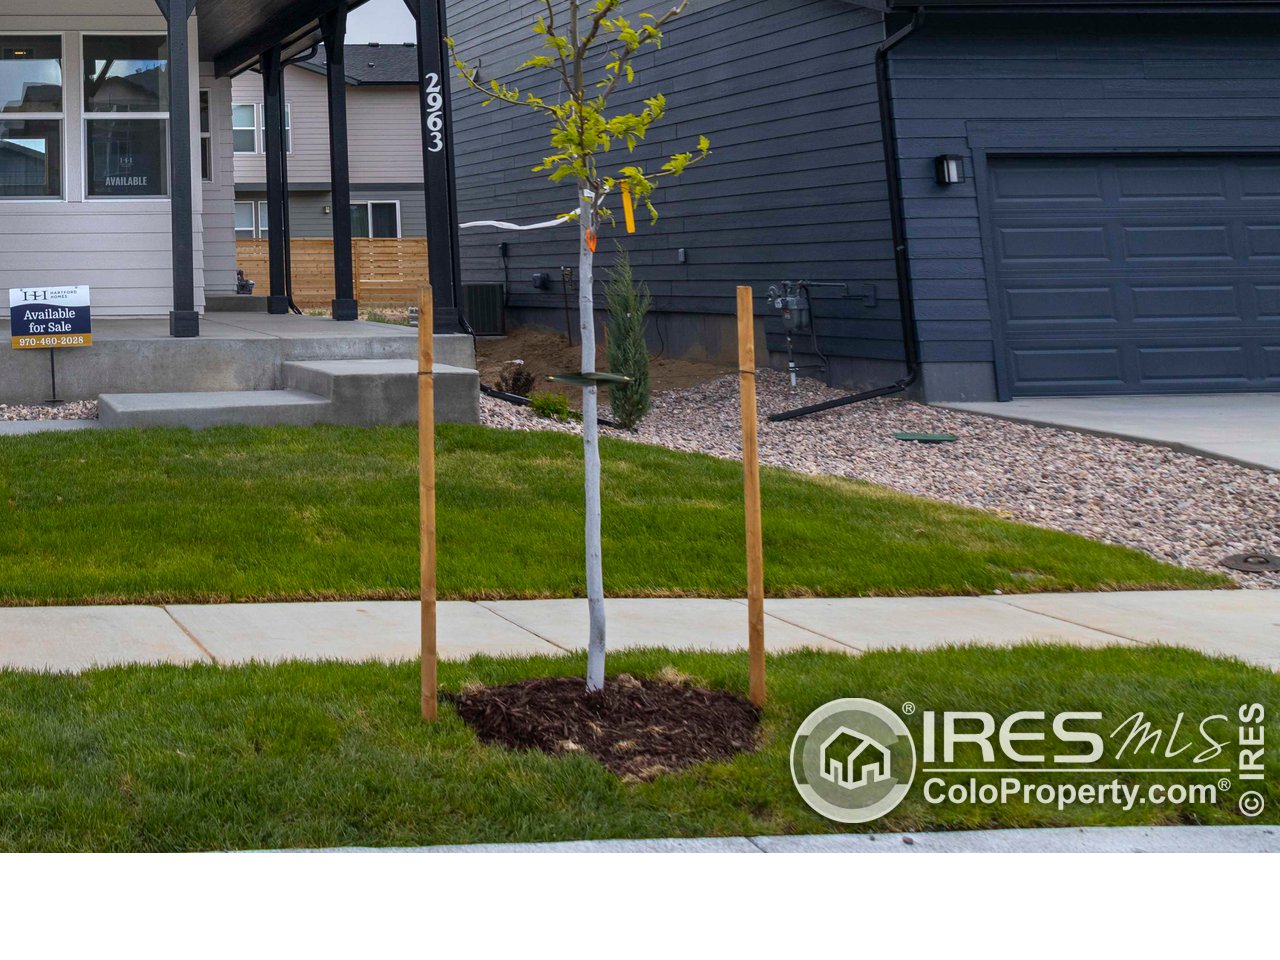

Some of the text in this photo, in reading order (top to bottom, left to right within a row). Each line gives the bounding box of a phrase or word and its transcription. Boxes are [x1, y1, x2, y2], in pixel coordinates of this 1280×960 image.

[425, 72, 443, 152] 2963
[105, 177, 147, 185] AVAILABLE
[24, 308, 76, 320] Available
[29, 321, 71, 333] for Sale
[20, 336, 83, 346] 970-460-2028
